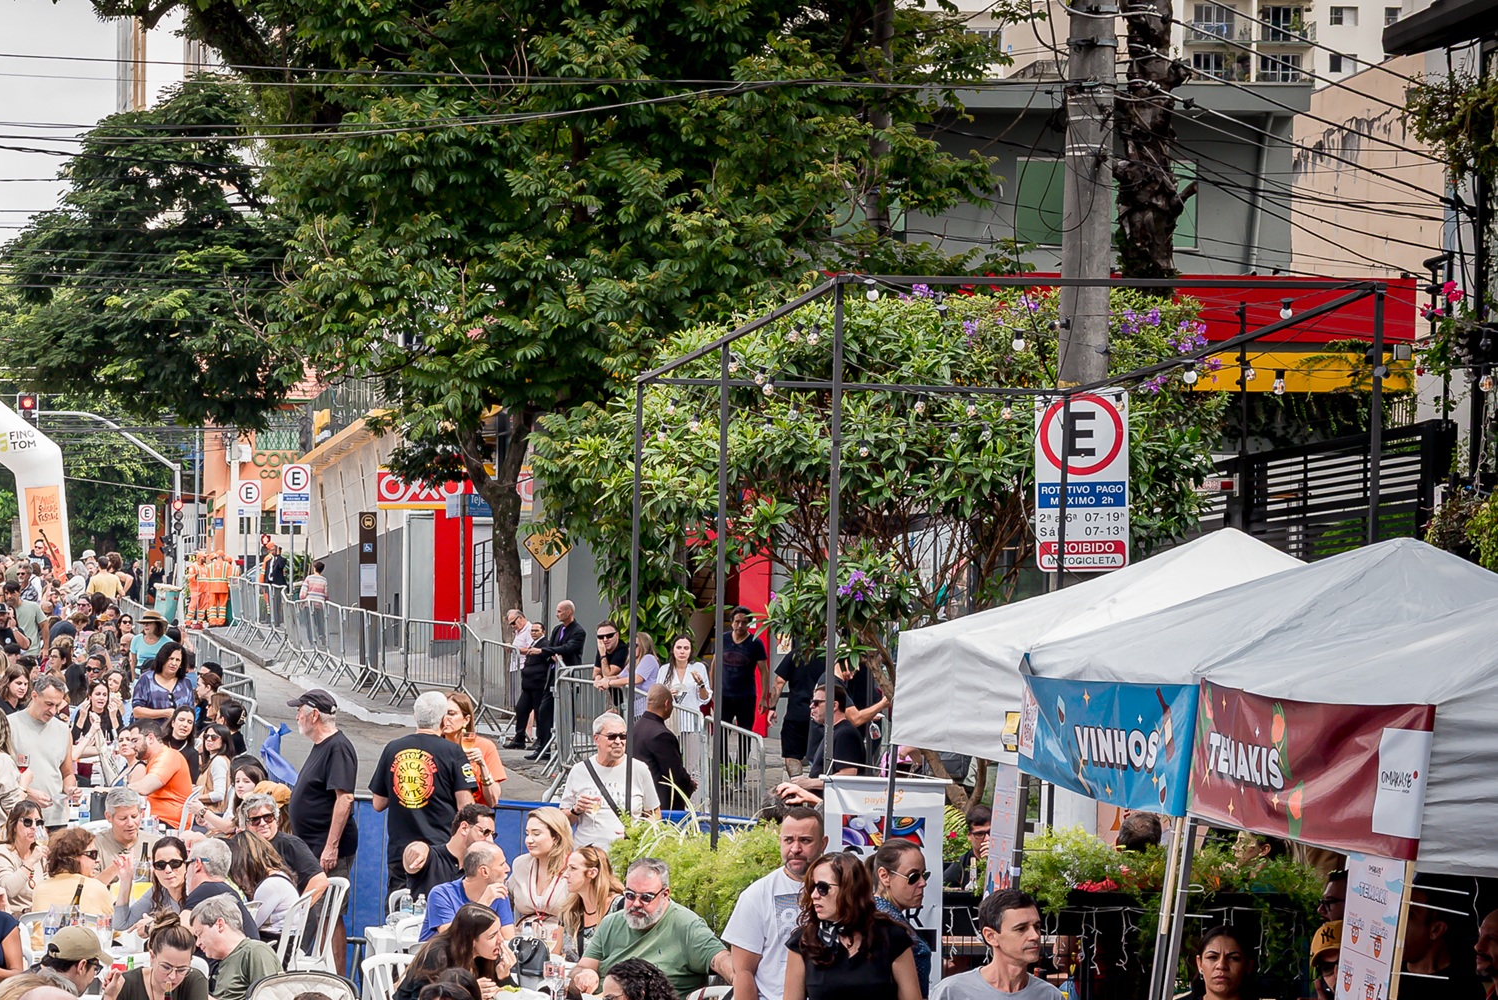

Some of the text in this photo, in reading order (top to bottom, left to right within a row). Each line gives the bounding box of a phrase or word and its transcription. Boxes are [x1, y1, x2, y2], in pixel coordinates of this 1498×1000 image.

[9, 430, 35, 441] FINO
[1067, 411, 1096, 457] E
[10, 439, 37, 451] TOM
[292, 471, 301, 486] E
[245, 486, 253, 500] E
[1041, 484, 1124, 494] ROTTIVO PAGO
[1051, 495, 1114, 505] MXIMO 2h
[144, 508, 151, 519] E
[1074, 725, 1161, 774] VINHOS
